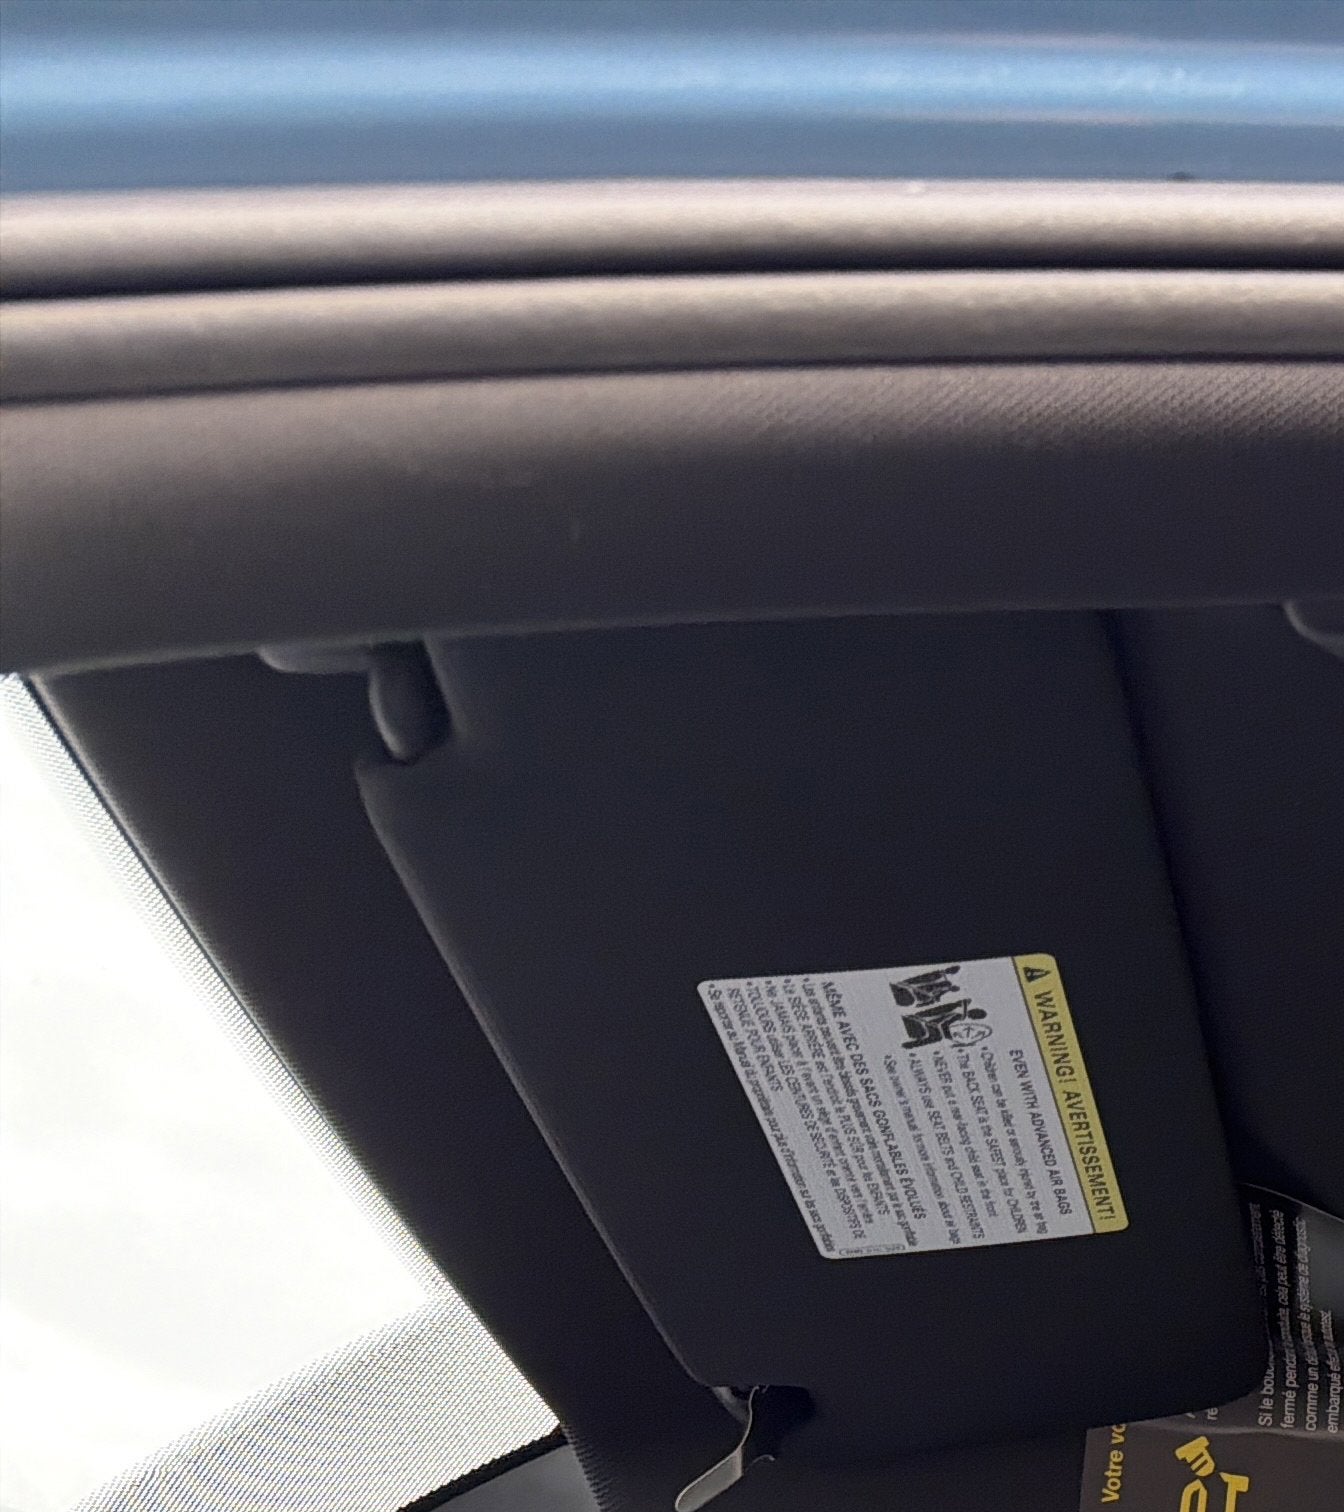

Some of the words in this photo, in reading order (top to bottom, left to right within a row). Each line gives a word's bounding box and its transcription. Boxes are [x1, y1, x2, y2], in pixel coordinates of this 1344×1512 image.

[819, 981, 851, 1018] MÊME
[835, 1019, 862, 1050] AVEC
[848, 1053, 872, 1075] DES
[907, 1058, 933, 1094] ALWAYS
[931, 1055, 953, 1084] NEVER
[1008, 1048, 1032, 1078] EVEN
[858, 1077, 884, 1107] SACS
[961, 1070, 981, 1095] BACK
[1017, 1080, 1041, 1108] WITH
[925, 1109, 947, 1131] SEAT
[969, 1095, 988, 1115] SEAT
[1032, 990, 1078, 1083] WARNING!
[1060, 1089, 1115, 1220] AVERTISSEMENT!
[870, 1109, 911, 1175] GONFLABLES
[933, 1131, 956, 1156] BELTS
[984, 1138, 1005, 1167] SAFEST
[1027, 1111, 1058, 1167] ADVANCED
[1044, 1168, 1064, 1186] AIR
[898, 1176, 930, 1220] ÉVOLUÉS
[1050, 1187, 1073, 1215] BAGS
[1005, 1198, 1028, 1233] CHILDREN
[1308, 1367, 1319, 1380] un
[1259, 1398, 1274, 1410] le
[1280, 1390, 1296, 1428] fermé
[1304, 1383, 1319, 1431] comme
[1324, 1373, 1344, 1433] embarqué
[1257, 1412, 1273, 1426] Si
[1100, 1450, 1125, 1504] Votre
